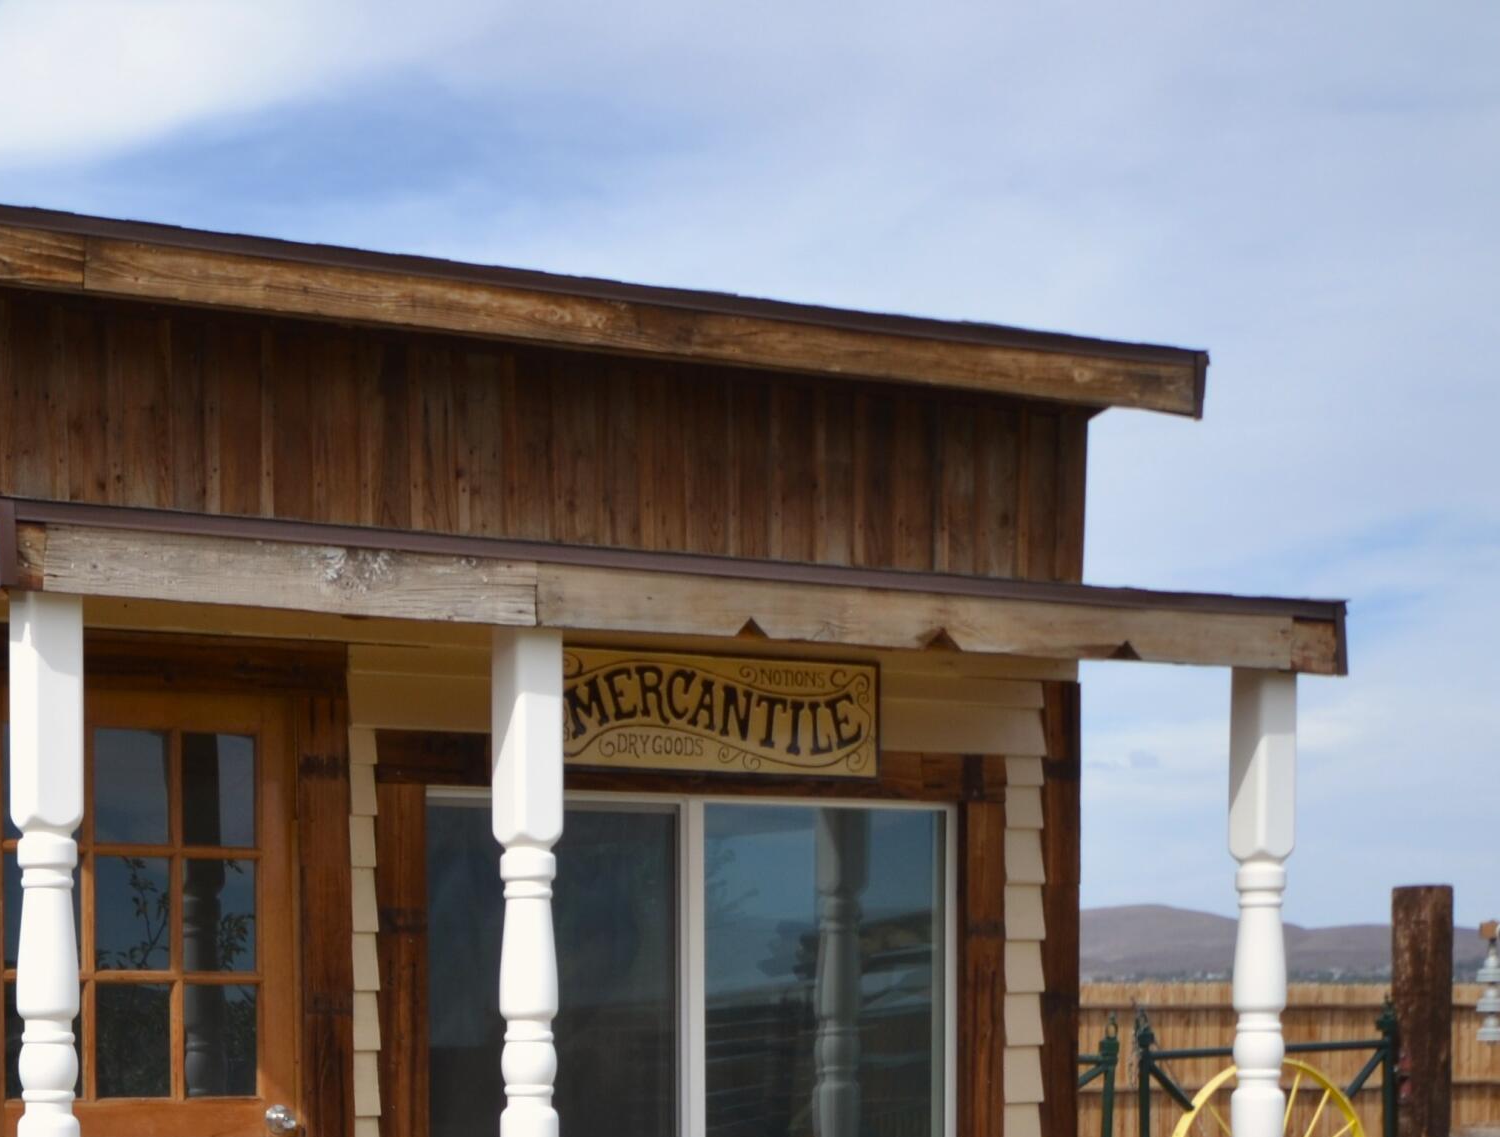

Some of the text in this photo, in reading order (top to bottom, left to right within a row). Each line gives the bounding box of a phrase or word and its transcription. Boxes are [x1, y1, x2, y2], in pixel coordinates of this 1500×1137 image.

[757, 667, 826, 688] NOTIONS
[564, 664, 862, 756] MERCANTILE
[616, 733, 704, 758] DRY GOODS
